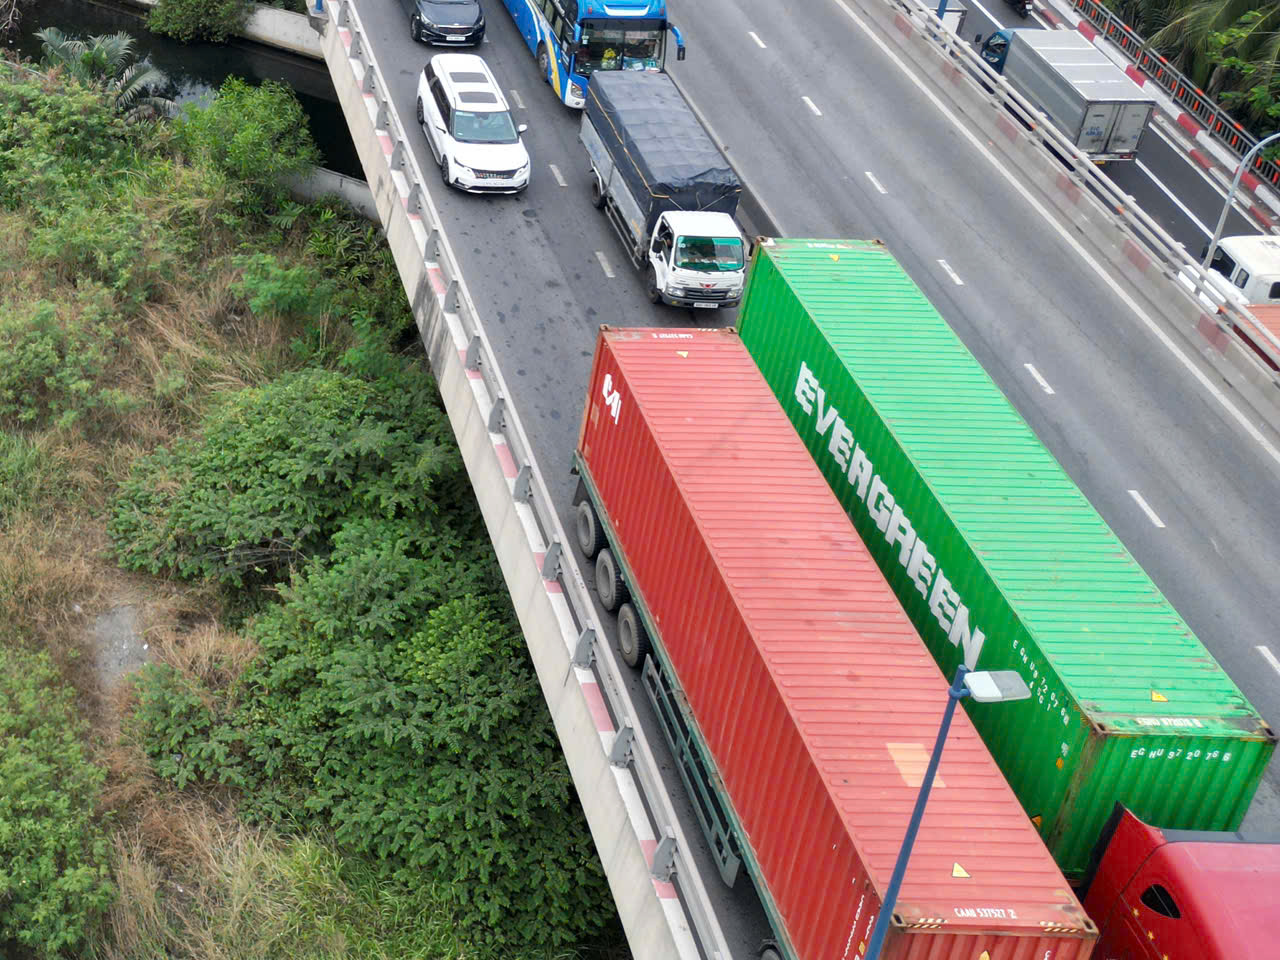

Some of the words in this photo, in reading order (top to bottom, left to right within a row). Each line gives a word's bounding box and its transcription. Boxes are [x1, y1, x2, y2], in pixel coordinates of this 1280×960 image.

[602, 373, 622, 425] CAI
[795, 361, 986, 672] EVERGREEN
[1130, 748, 1165, 759] EGHU
